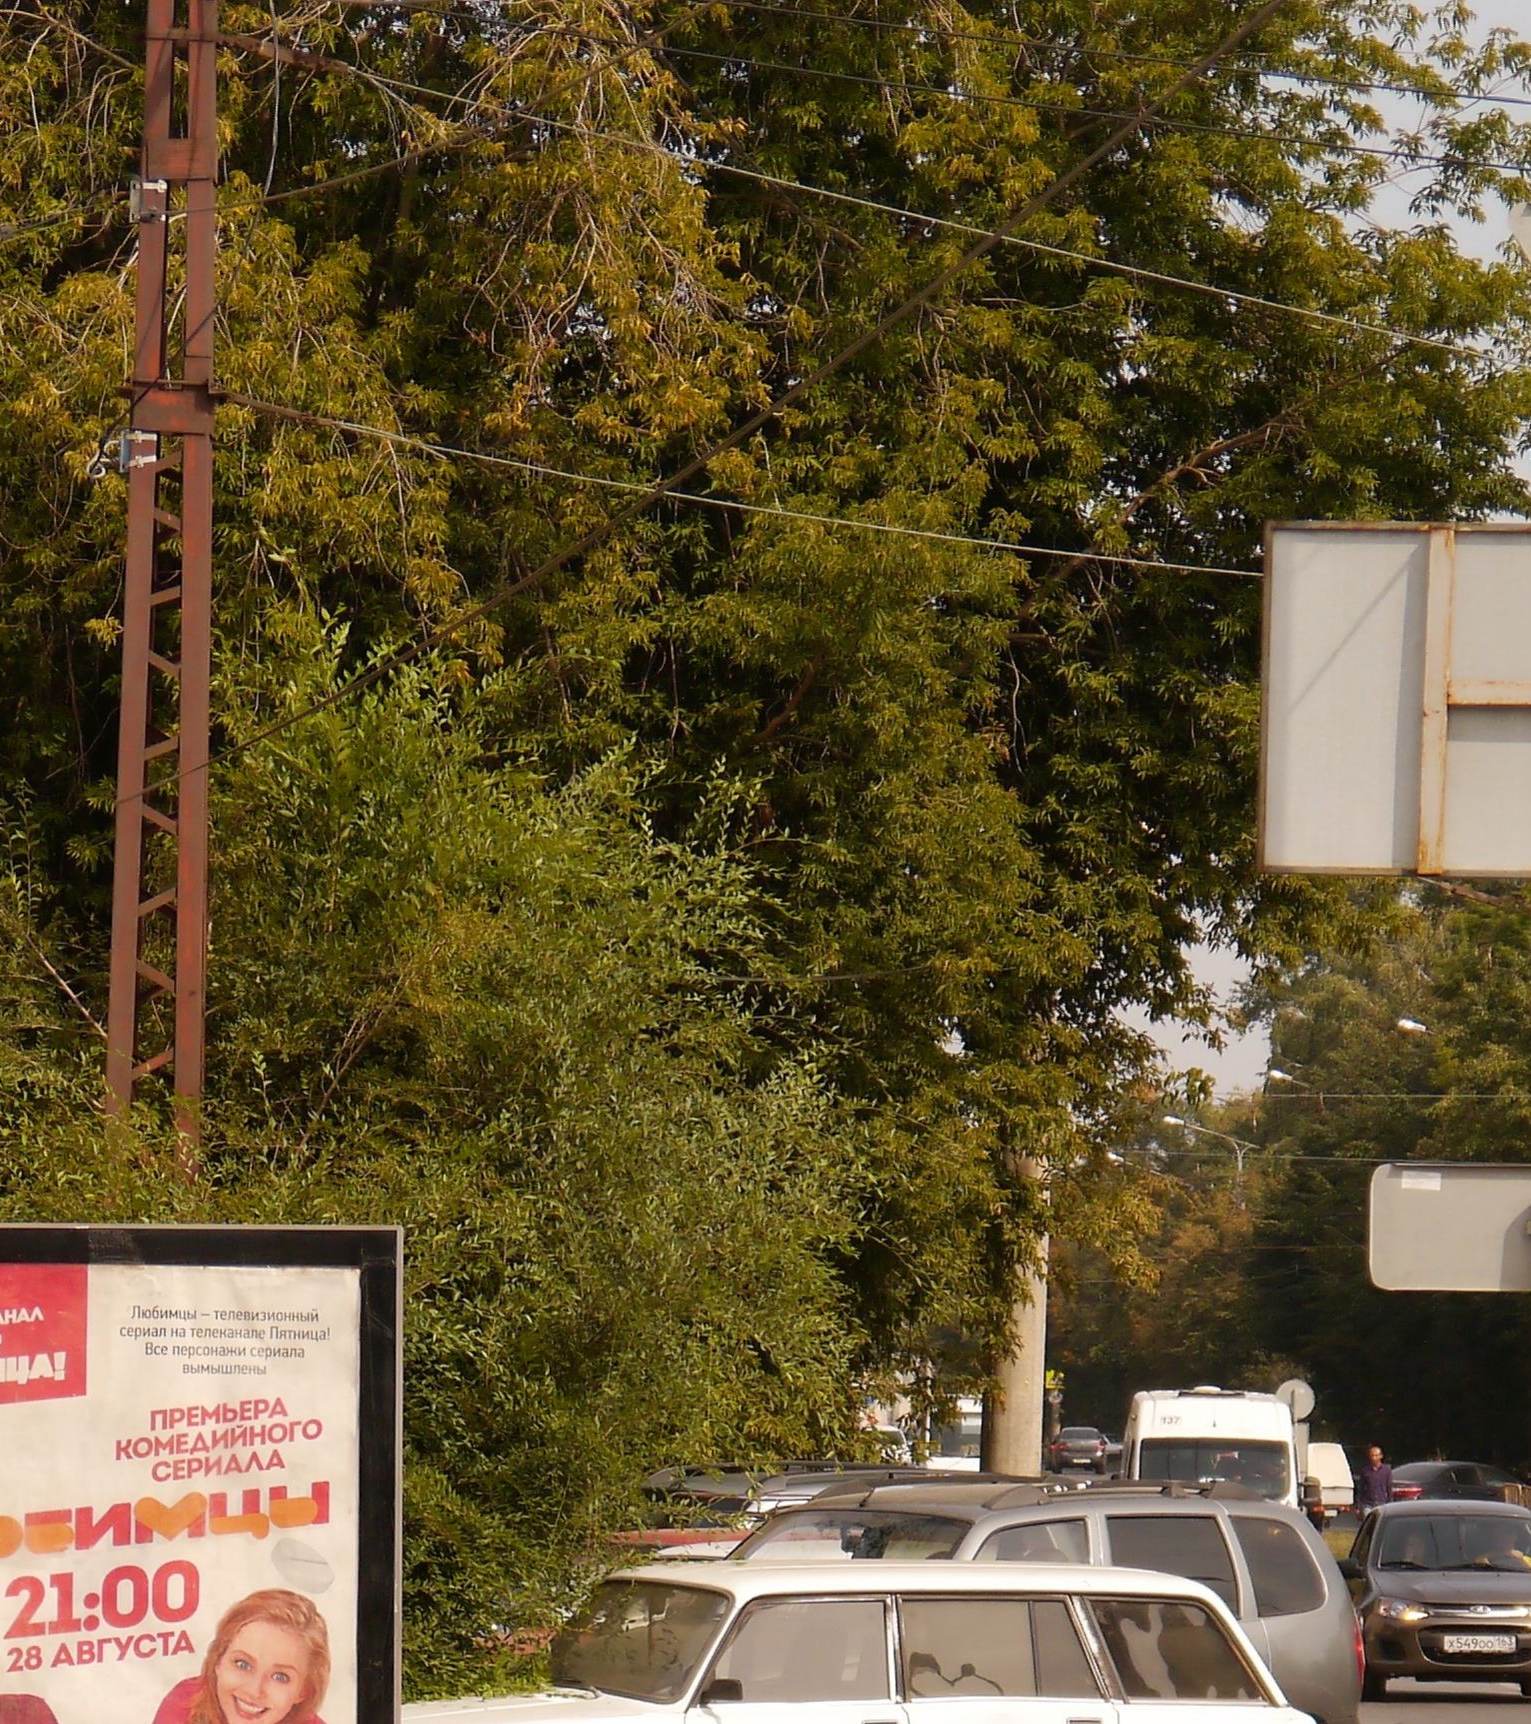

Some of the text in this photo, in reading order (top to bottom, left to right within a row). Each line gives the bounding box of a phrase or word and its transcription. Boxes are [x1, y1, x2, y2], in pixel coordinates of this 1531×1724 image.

[130, 1305, 197, 1321] Любимцы
[214, 1308, 319, 1322] телевизионный
[119, 1324, 330, 1342] сериал на телеканале Пятница!
[145, 1342, 305, 1360] Все персонажи сериала
[182, 1363, 267, 1375] вымышлены
[150, 1397, 288, 1431] ПРЕМЬЕРА
[115, 1418, 323, 1461] КОМЕДИЙНОГО
[151, 1449, 286, 1482] СЕРИАЛА
[3, 1560, 200, 1640] 21:00
[6, 1629, 196, 1673] 28 АВГУСТА
